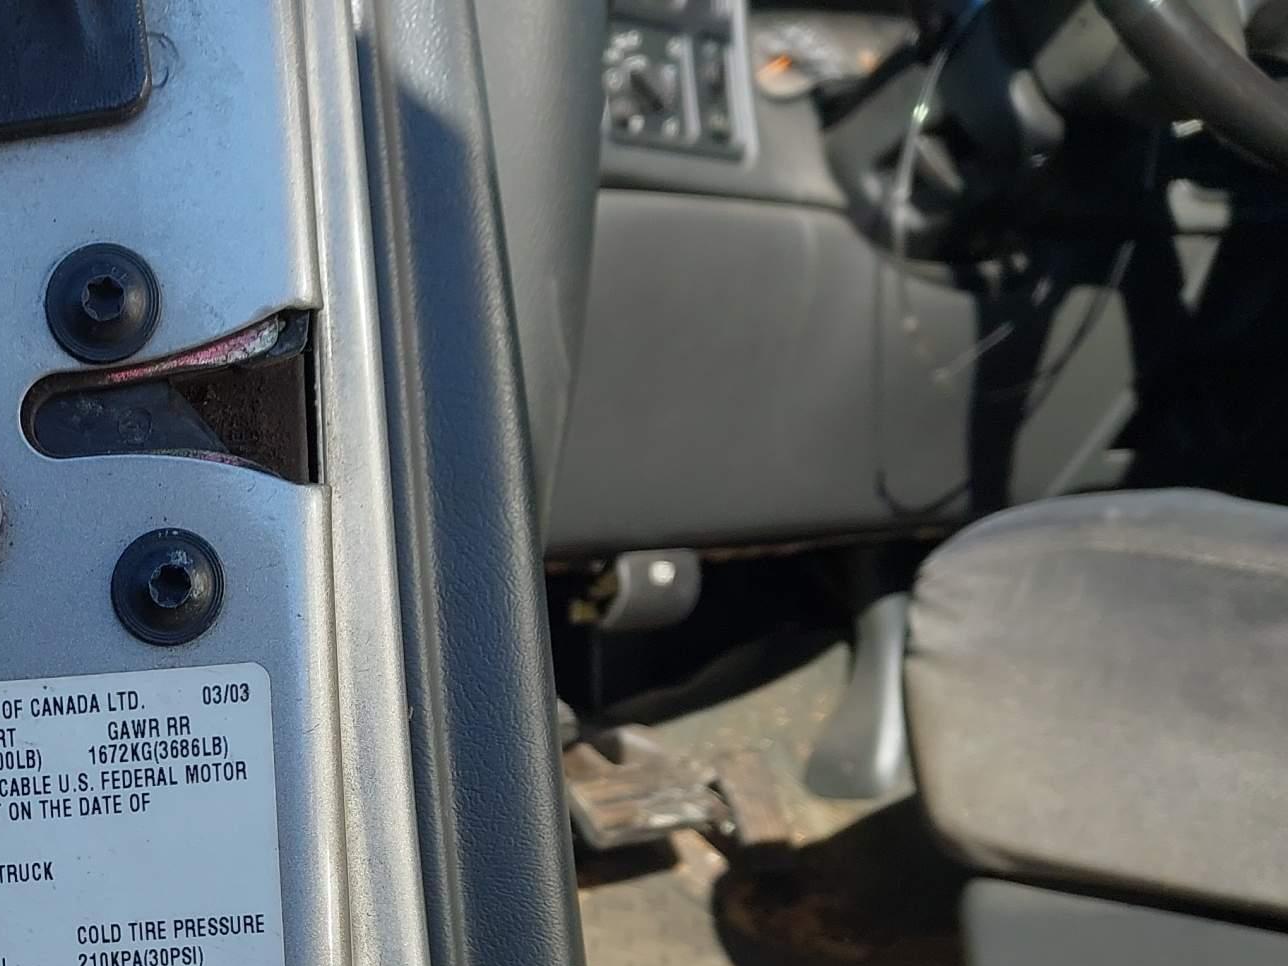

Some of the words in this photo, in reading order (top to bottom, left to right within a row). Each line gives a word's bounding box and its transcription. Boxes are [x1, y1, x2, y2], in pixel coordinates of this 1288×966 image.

[2, 699, 22, 719] OF
[31, 694, 100, 717] CANADA
[108, 691, 144, 711] LTD.
[203, 683, 249, 705] 03/03
[108, 718, 160, 740] GAWR
[167, 716, 190, 736] RR
[88, 736, 229, 764] 1672KG(3686LB)
[59, 773, 94, 793] U.S.
[101, 766, 178, 790] FEDERAL
[186, 761, 247, 784] MOTOR
[9, 801, 31, 821] ON
[39, 798, 72, 819] THE
[79, 795, 122, 816] DATE
[130, 793, 150, 812] OF
[77, 924, 121, 944] COLD
[128, 921, 166, 941] TIRE
[174, 914, 264, 938] PRESSURE
